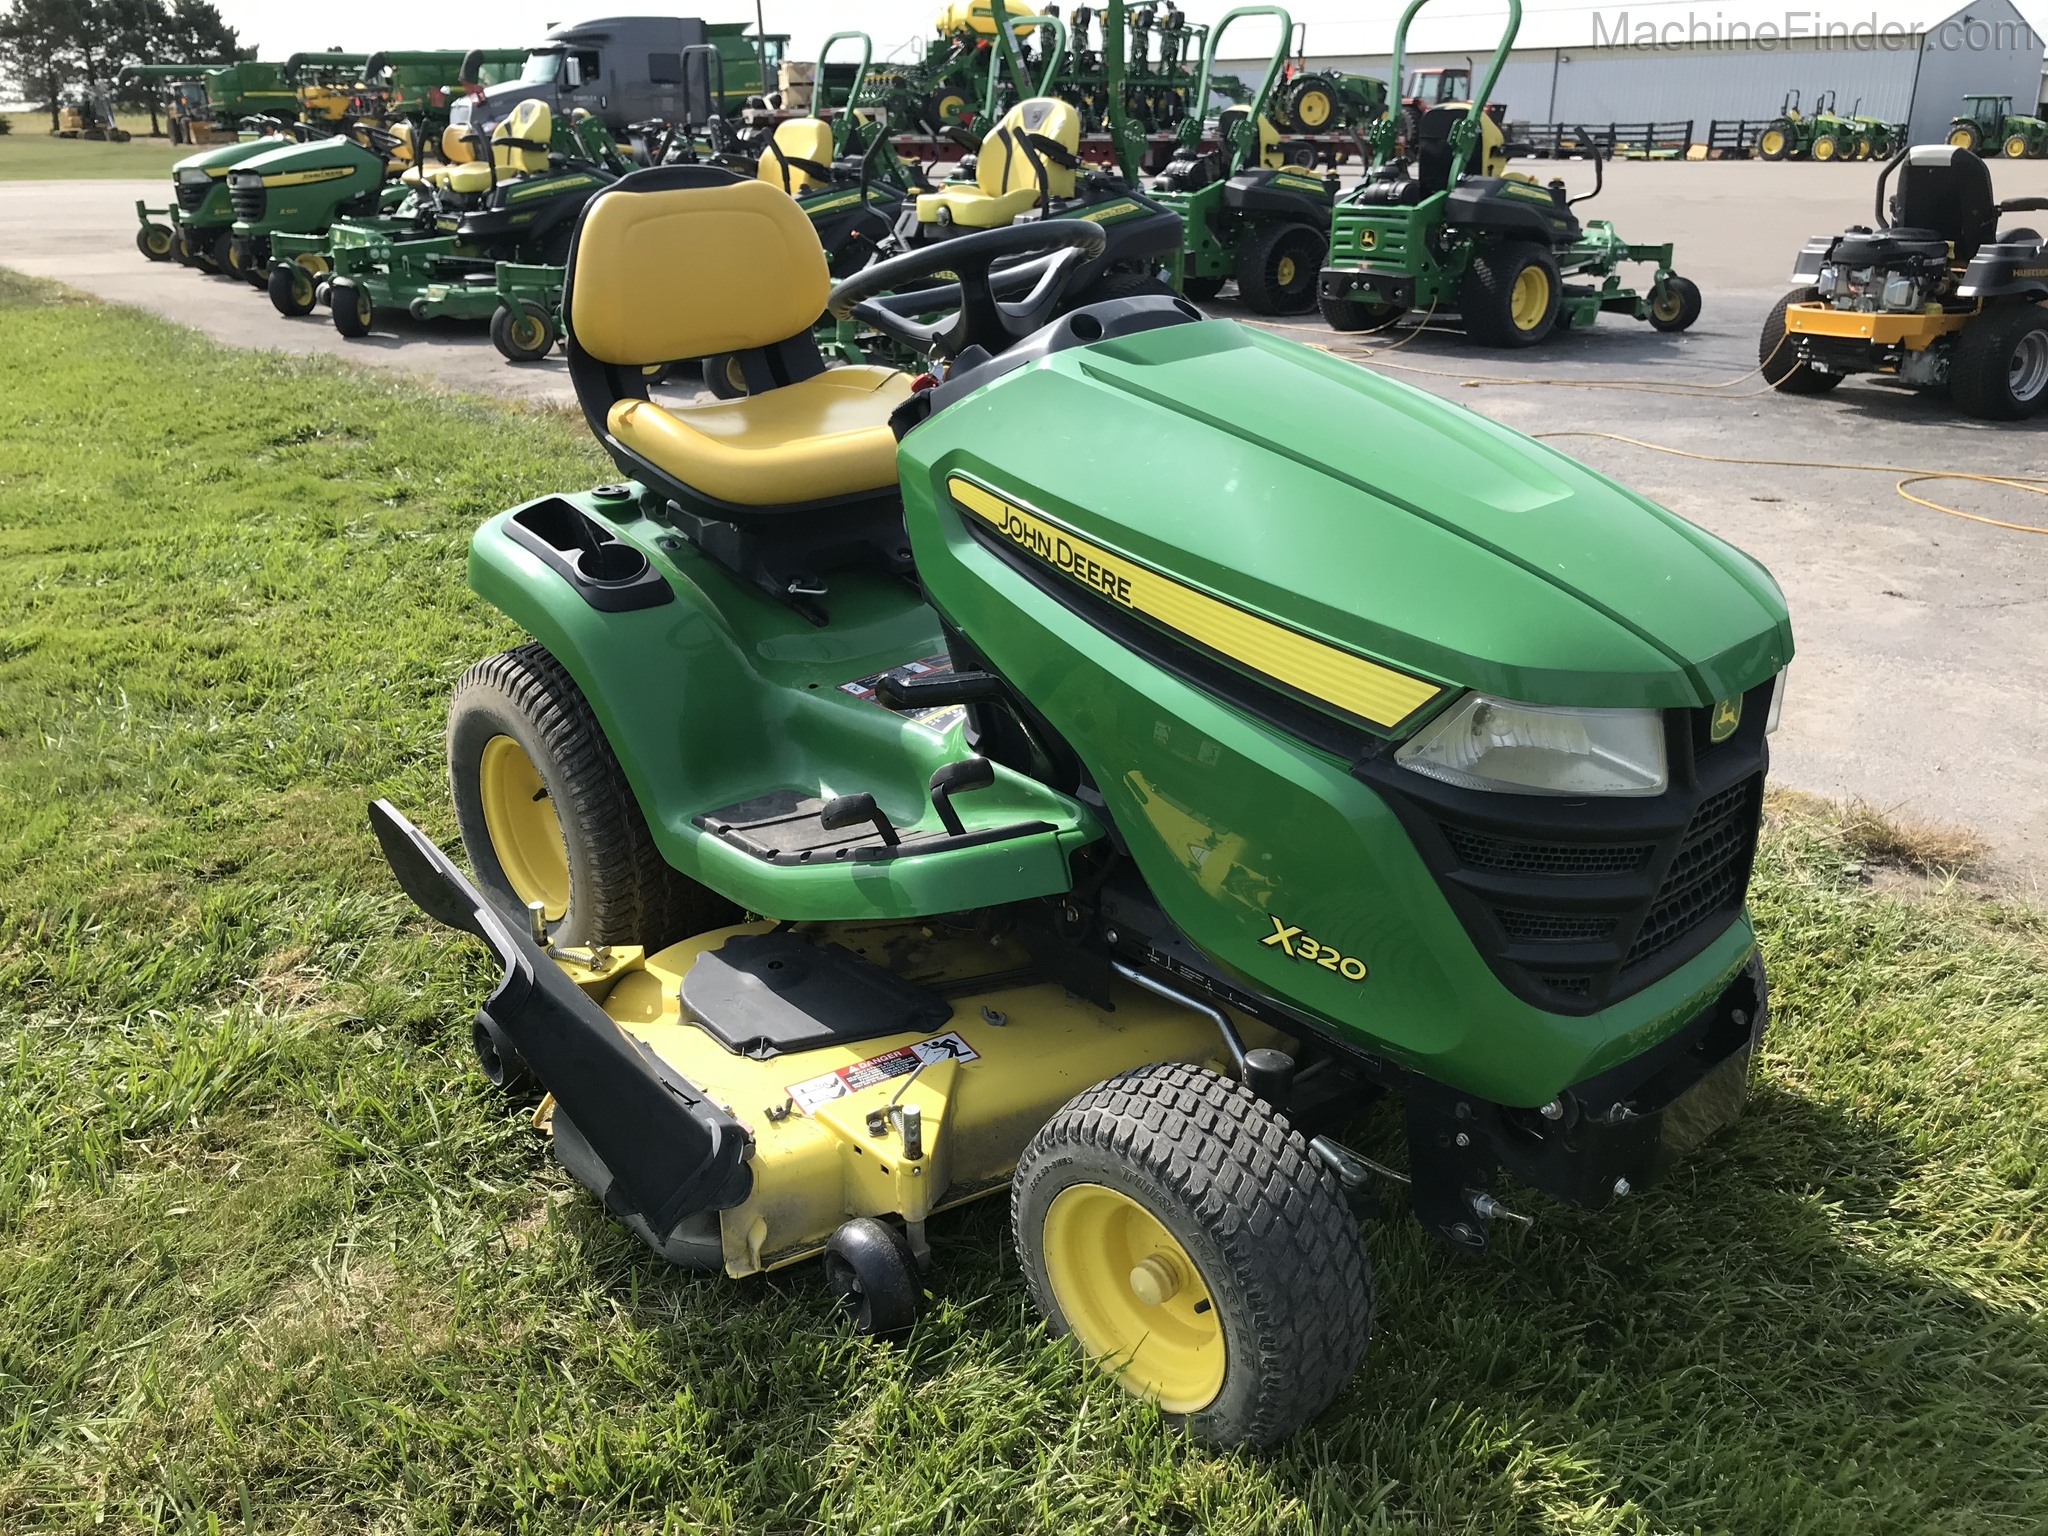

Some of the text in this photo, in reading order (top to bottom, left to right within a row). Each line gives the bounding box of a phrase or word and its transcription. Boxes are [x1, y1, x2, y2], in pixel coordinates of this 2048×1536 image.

[997, 506, 1133, 605] JOHN DEERE
[1259, 914, 1367, 981] X320
[858, 1050, 903, 1069] DANGER
[1120, 1165, 1256, 1371] TURF MASTER
